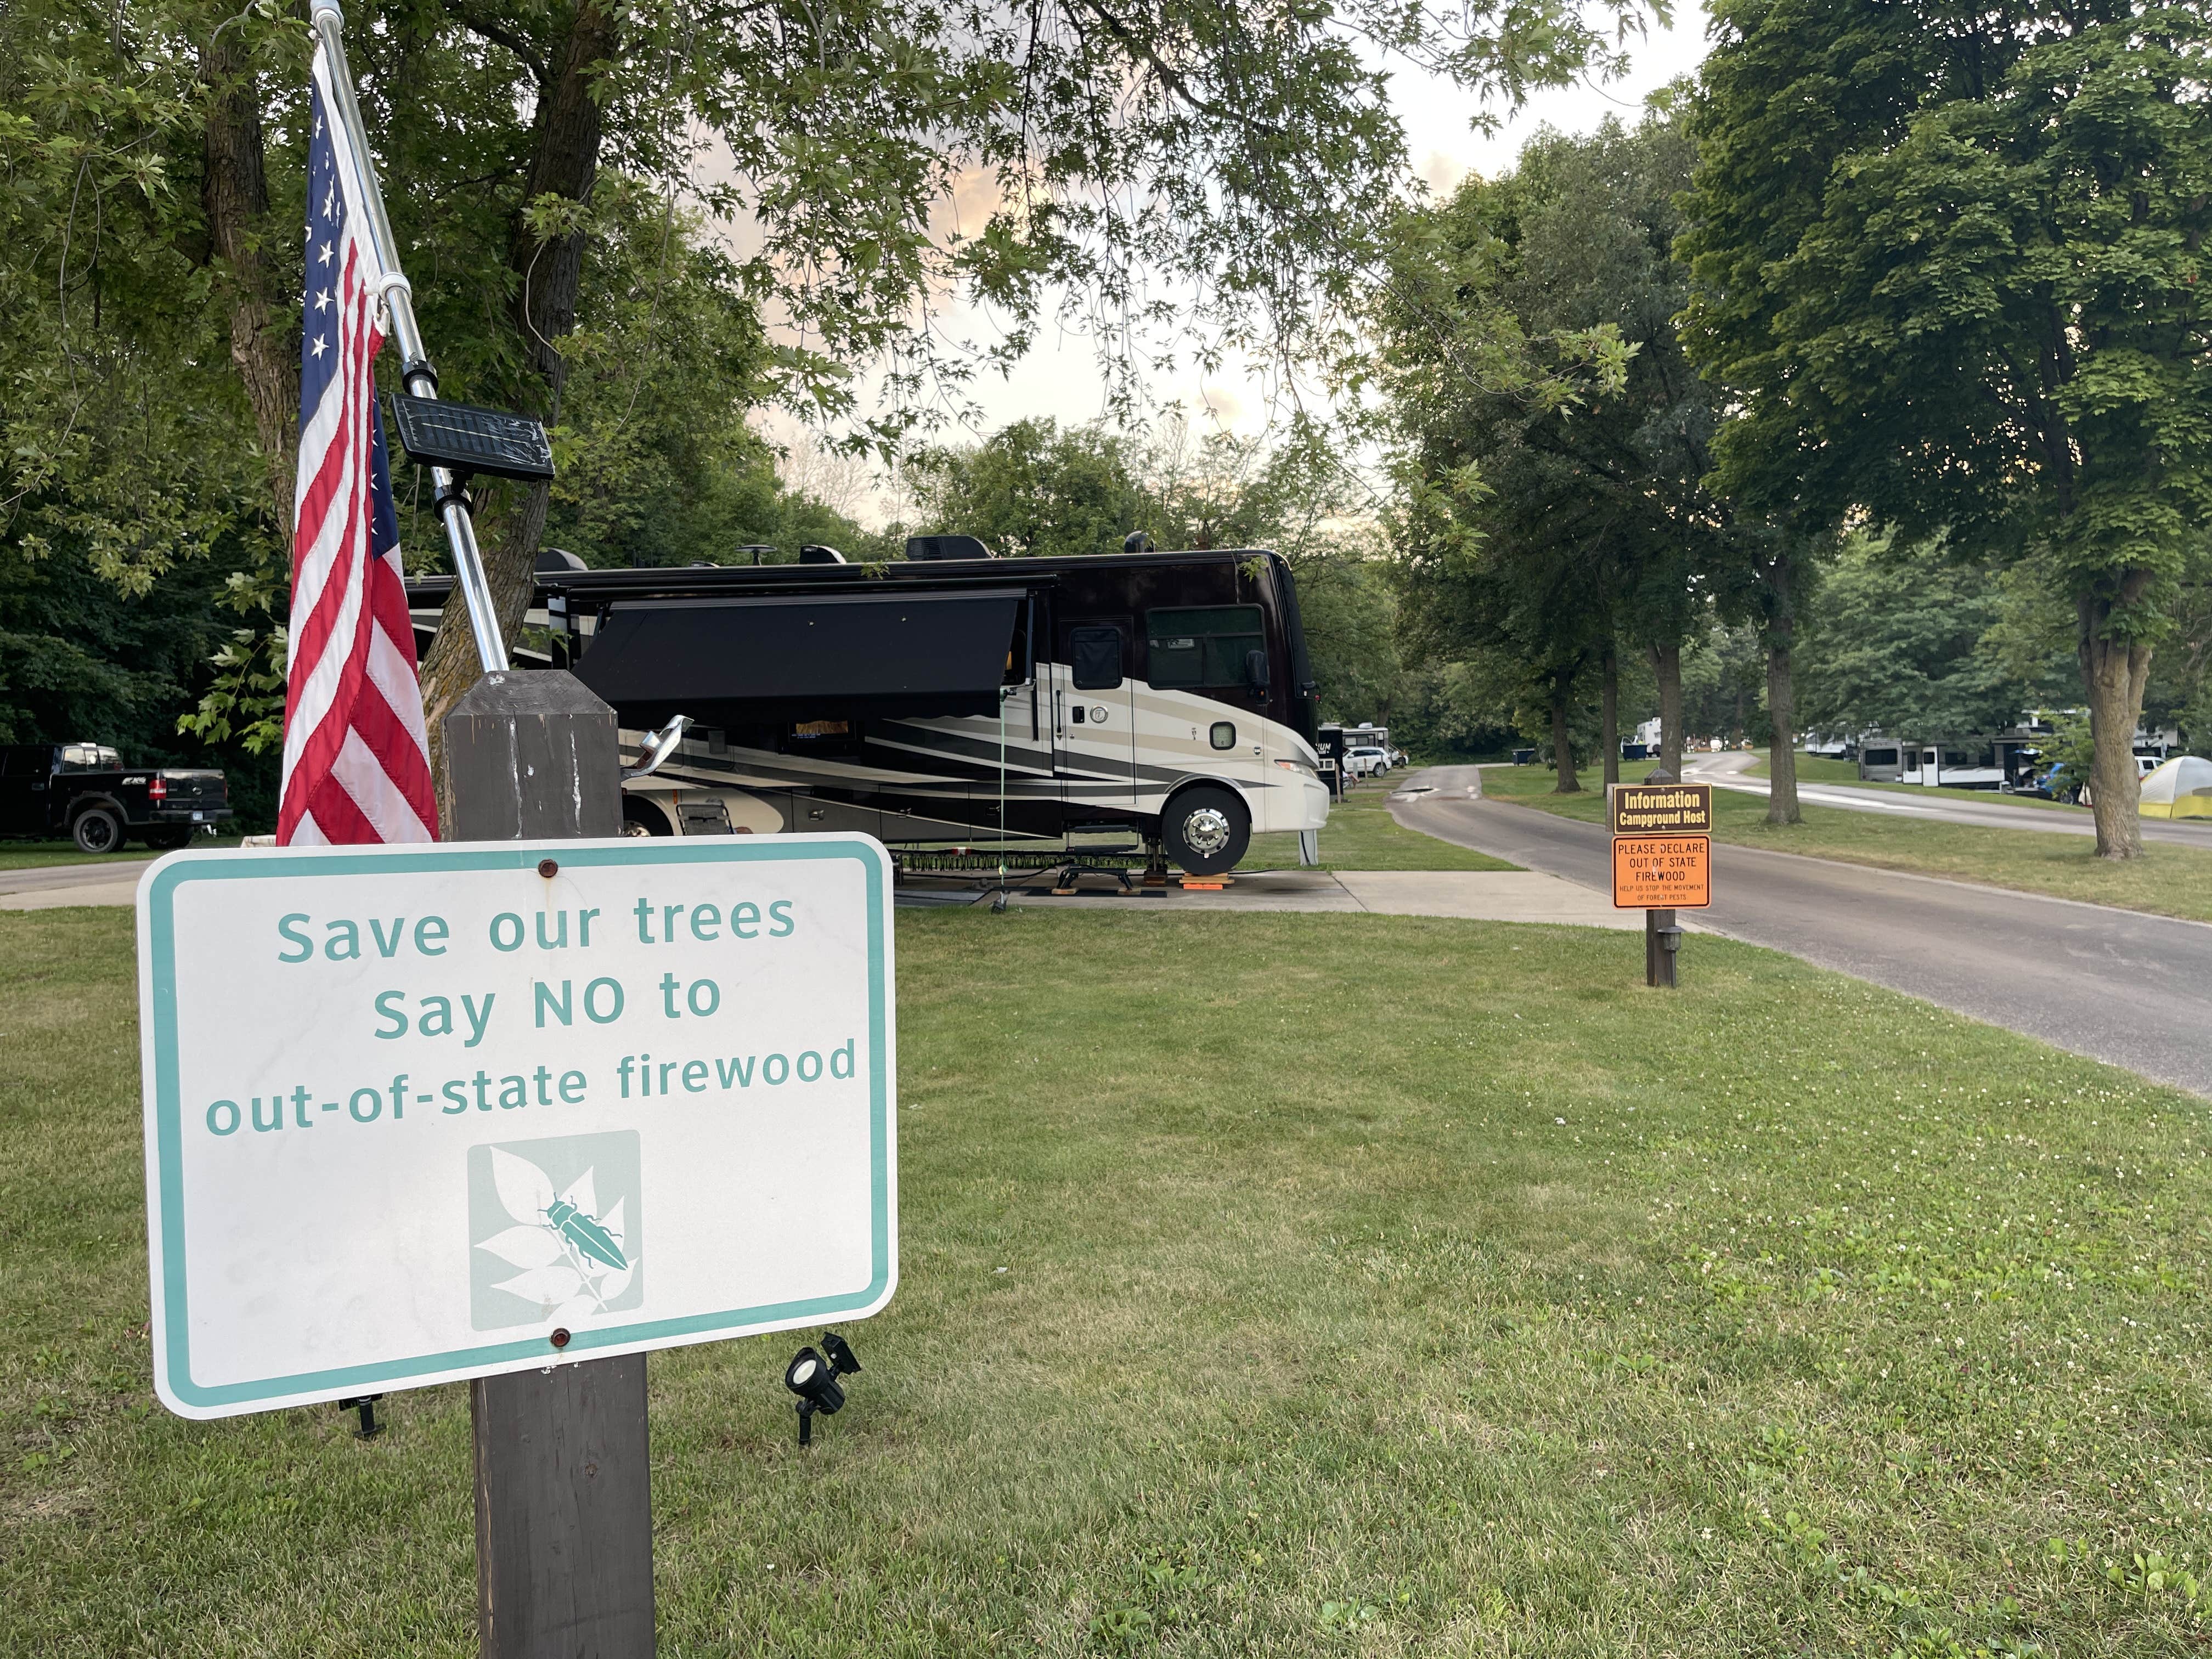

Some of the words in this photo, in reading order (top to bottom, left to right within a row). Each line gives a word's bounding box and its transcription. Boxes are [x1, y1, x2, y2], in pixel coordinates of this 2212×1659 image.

[1624, 790, 1700, 809] Information
[1620, 810, 1680, 827] Campground
[1683, 810, 1706, 823] Host
[1618, 844, 1656, 854] PLEASE
[1660, 843, 1705, 854] DECLARE
[1629, 858, 1649, 868] OUT
[1652, 857, 1664, 867] OF
[1669, 857, 1696, 867] STATE
[1636, 871, 1685, 881] FIREWOOD
[279, 912, 450, 963] Save
[489, 905, 600, 951] our
[633, 898, 794, 943] trees
[375, 989, 496, 1047] Say
[535, 977, 625, 1028] NO
[659, 972, 721, 1018] to
[206, 1065, 588, 1136] out-of-state
[617, 1038, 856, 1098] firewood
